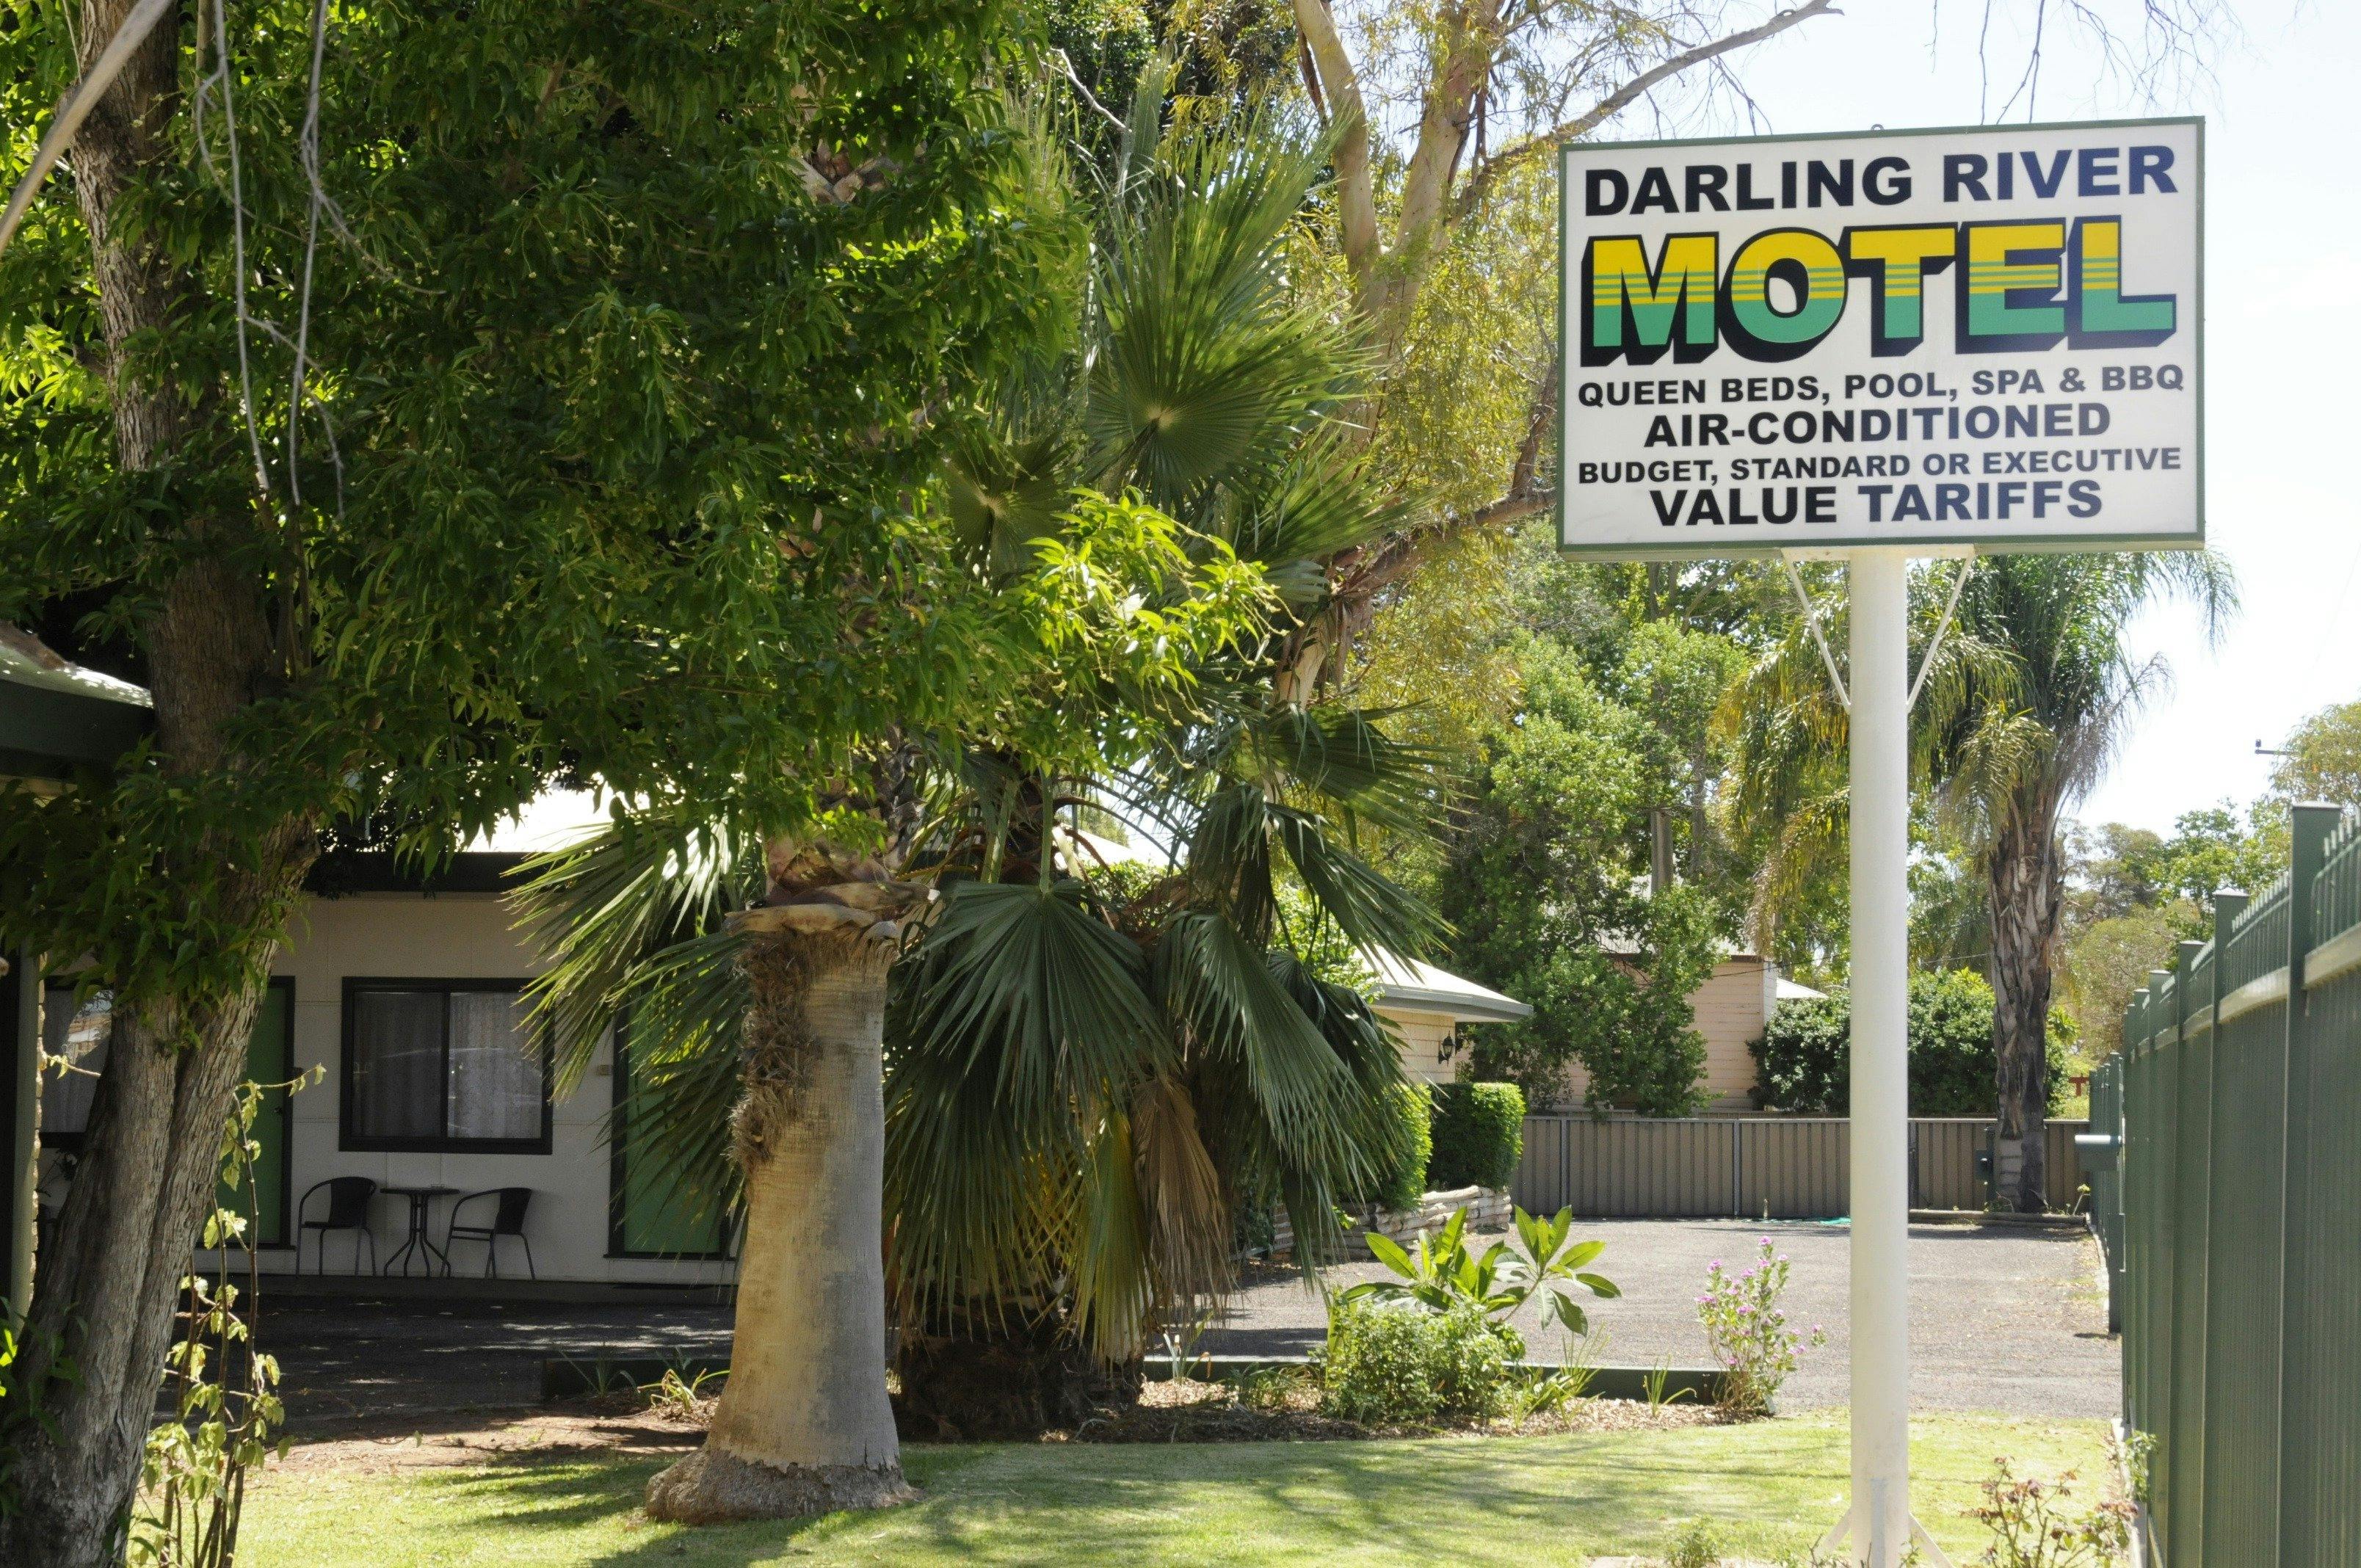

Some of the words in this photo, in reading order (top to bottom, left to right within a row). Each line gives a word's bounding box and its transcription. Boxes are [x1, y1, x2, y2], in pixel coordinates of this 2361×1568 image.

[1586, 157, 1911, 216] DARLING
[1943, 146, 2177, 202] RIVER
[1581, 215, 2176, 367] MOTEL
[1578, 380, 1705, 408] QUEEN
[1722, 376, 1829, 405] BEDS,
[1846, 373, 1956, 401] POOL,
[1973, 369, 2044, 395] SPA
[2060, 368, 2085, 392] &
[2103, 365, 2183, 391] BBQ
[1644, 403, 2109, 447] AIR-CONDITIONED
[1579, 460, 1717, 486] BUDGET,
[1731, 455, 1910, 480] STANDARD
[1923, 454, 1970, 475] OR
[1984, 448, 2180, 473] EXECUTIVE
[1650, 486, 1837, 526] VALUE
[1858, 480, 2101, 522] TARIFFS
